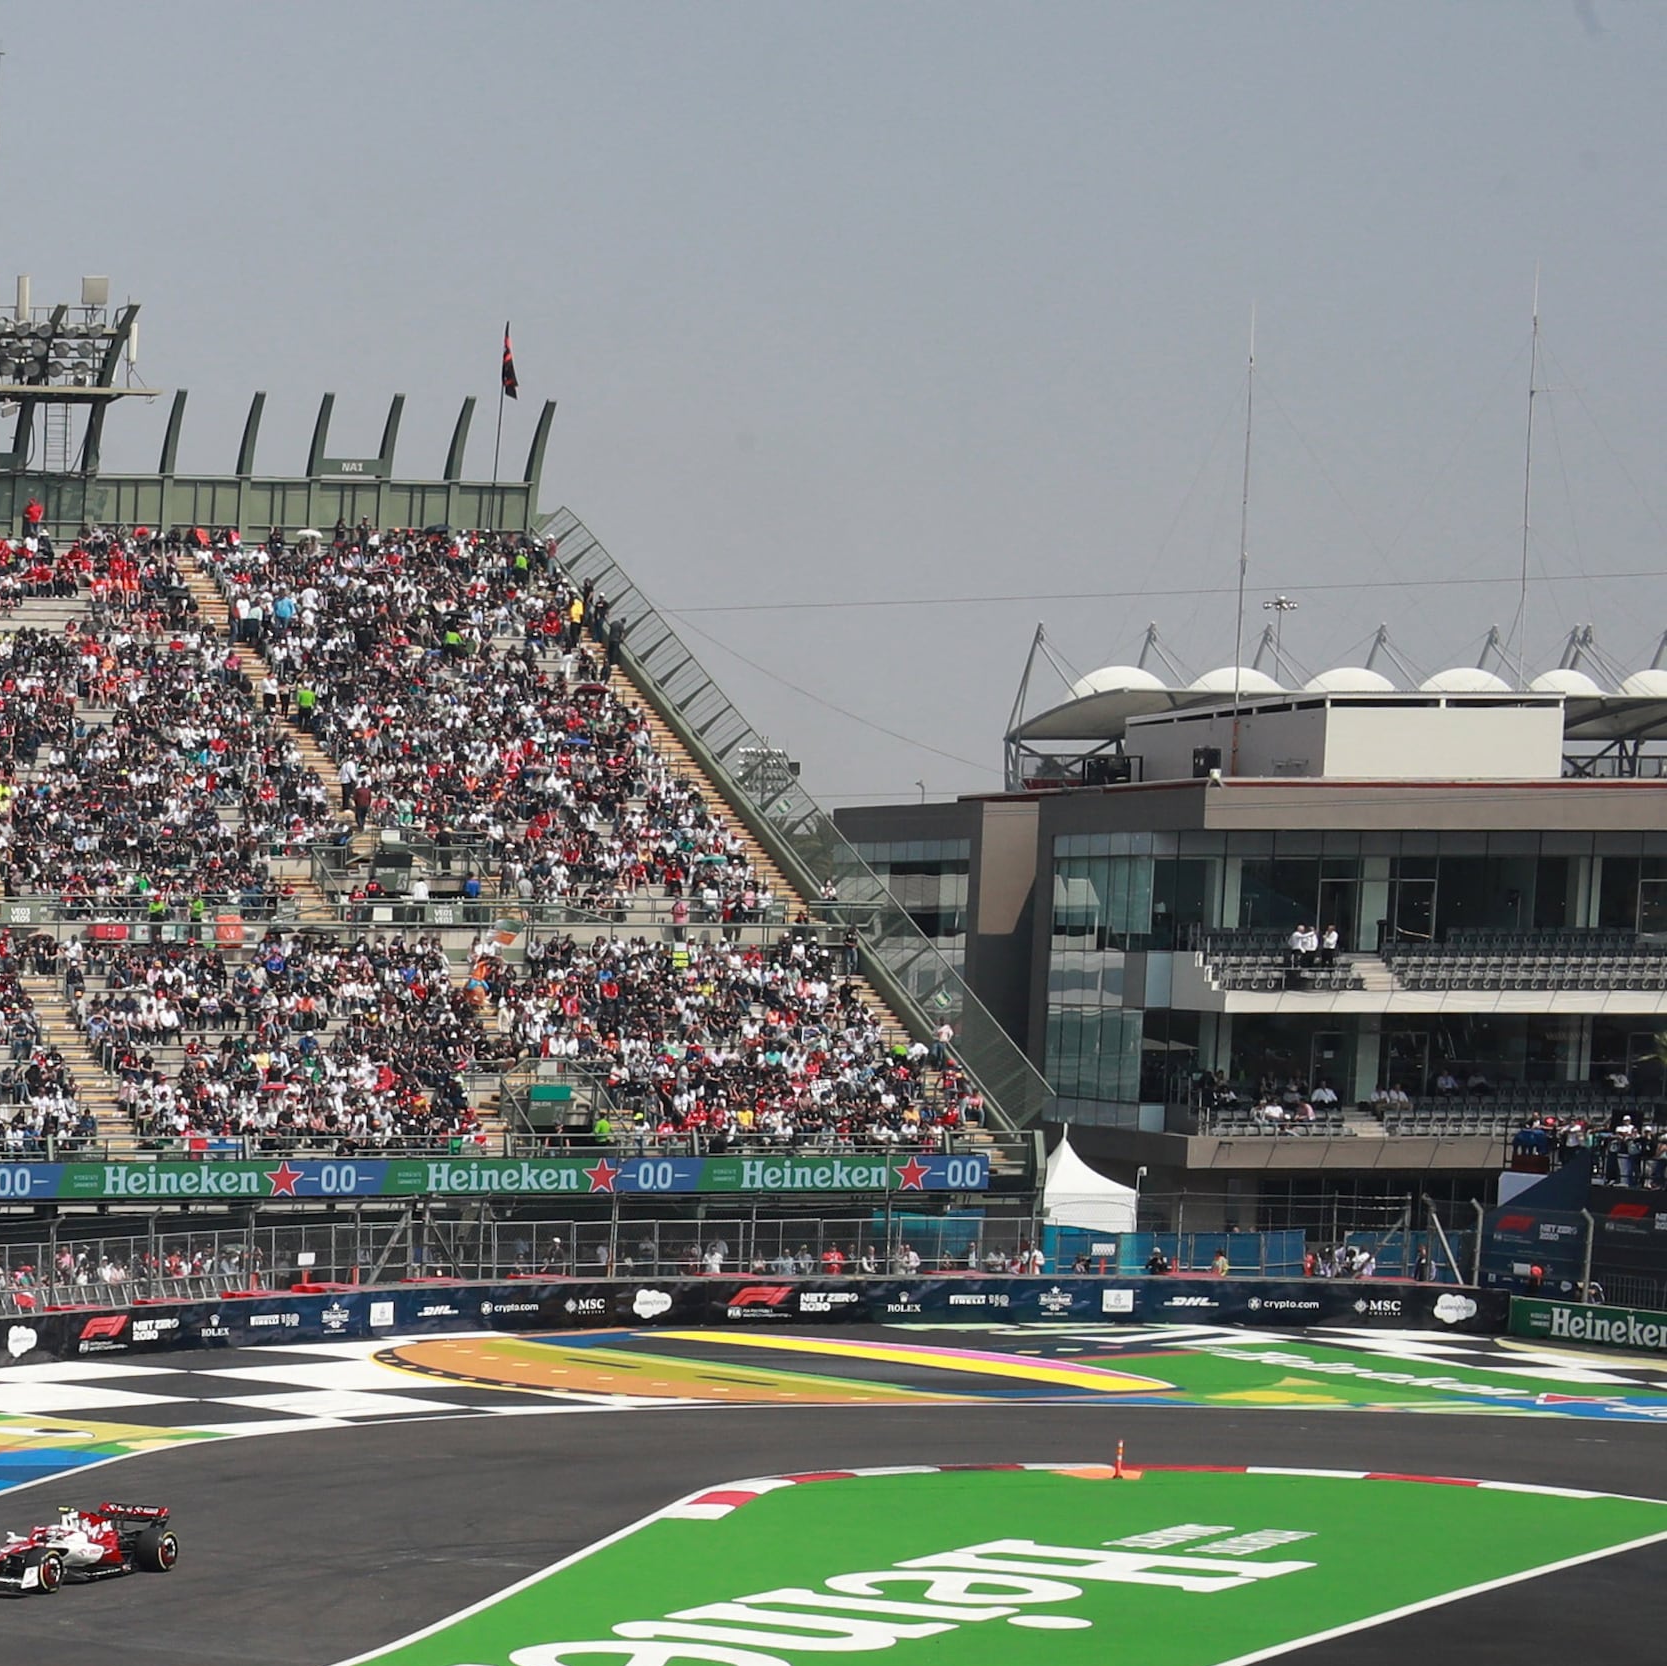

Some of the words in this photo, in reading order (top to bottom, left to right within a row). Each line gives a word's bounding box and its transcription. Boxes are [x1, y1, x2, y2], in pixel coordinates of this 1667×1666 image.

[341, 462, 364, 472] NA1
[103, 1165, 260, 1195] Heineken
[321, 1165, 357, 1193] 0.0
[426, 1162, 578, 1191] Heineken
[638, 1162, 673, 1190] 0.0
[741, 1161, 888, 1188] Heineken
[947, 1160, 980, 1188] 0.0
[799, 1293, 826, 1303] NET
[827, 1292, 859, 1303] ZERO
[1171, 1295, 1211, 1308] DHL
[424, 1304, 453, 1317] DHL
[494, 1301, 539, 1313] crypto.com
[578, 1298, 606, 1311] MSC
[799, 1302, 831, 1312] 2030
[887, 1303, 922, 1314] ROLEX
[1263, 1298, 1320, 1312] crypto.com
[1369, 1299, 1402, 1312] MSC
[133, 1321, 153, 1333] NET
[154, 1318, 179, 1330] ZERO
[133, 1330, 159, 1342] 2030
[202, 1327, 230, 1338] ROLEX
